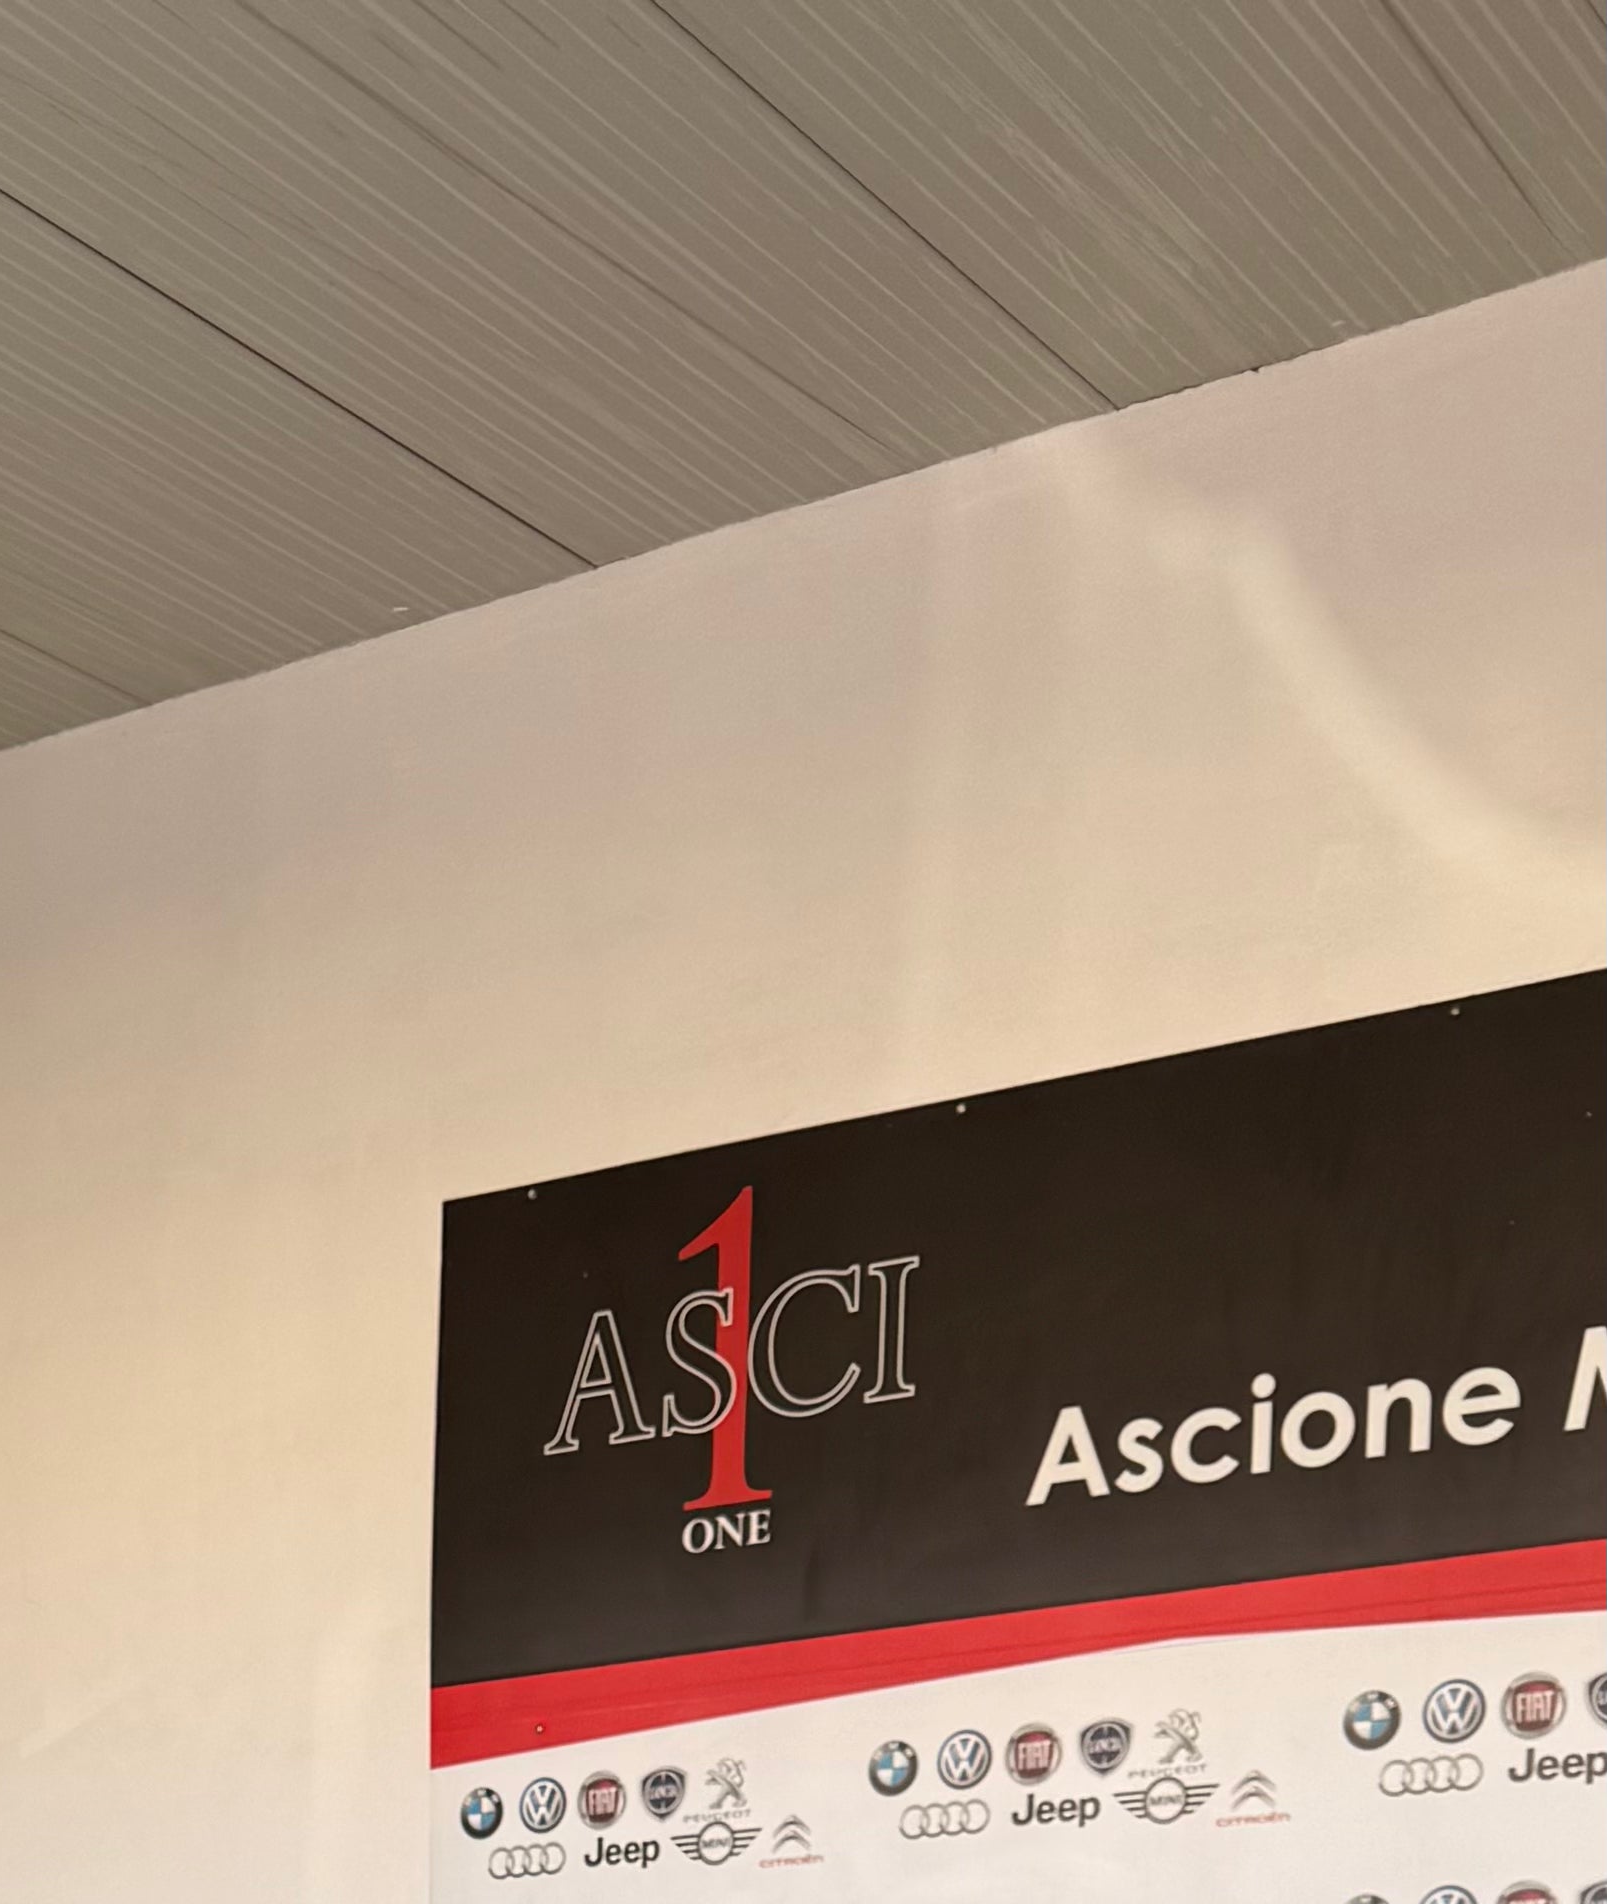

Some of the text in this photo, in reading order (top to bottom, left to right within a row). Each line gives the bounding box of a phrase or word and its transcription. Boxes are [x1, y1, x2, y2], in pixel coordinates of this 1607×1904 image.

[543, 1255, 920, 1456] ASCI
[1026, 1365, 1522, 1507] Ascione
[681, 1508, 772, 1555] ONE
[1516, 1691, 1554, 1722] FIAT
[1018, 1740, 1053, 1768] FIAT
[1508, 1748, 1607, 1784] Jeep
[588, 1786, 618, 1812] FIAT
[1011, 1793, 1101, 1827] Jeep
[584, 1837, 660, 1868] Jeep
